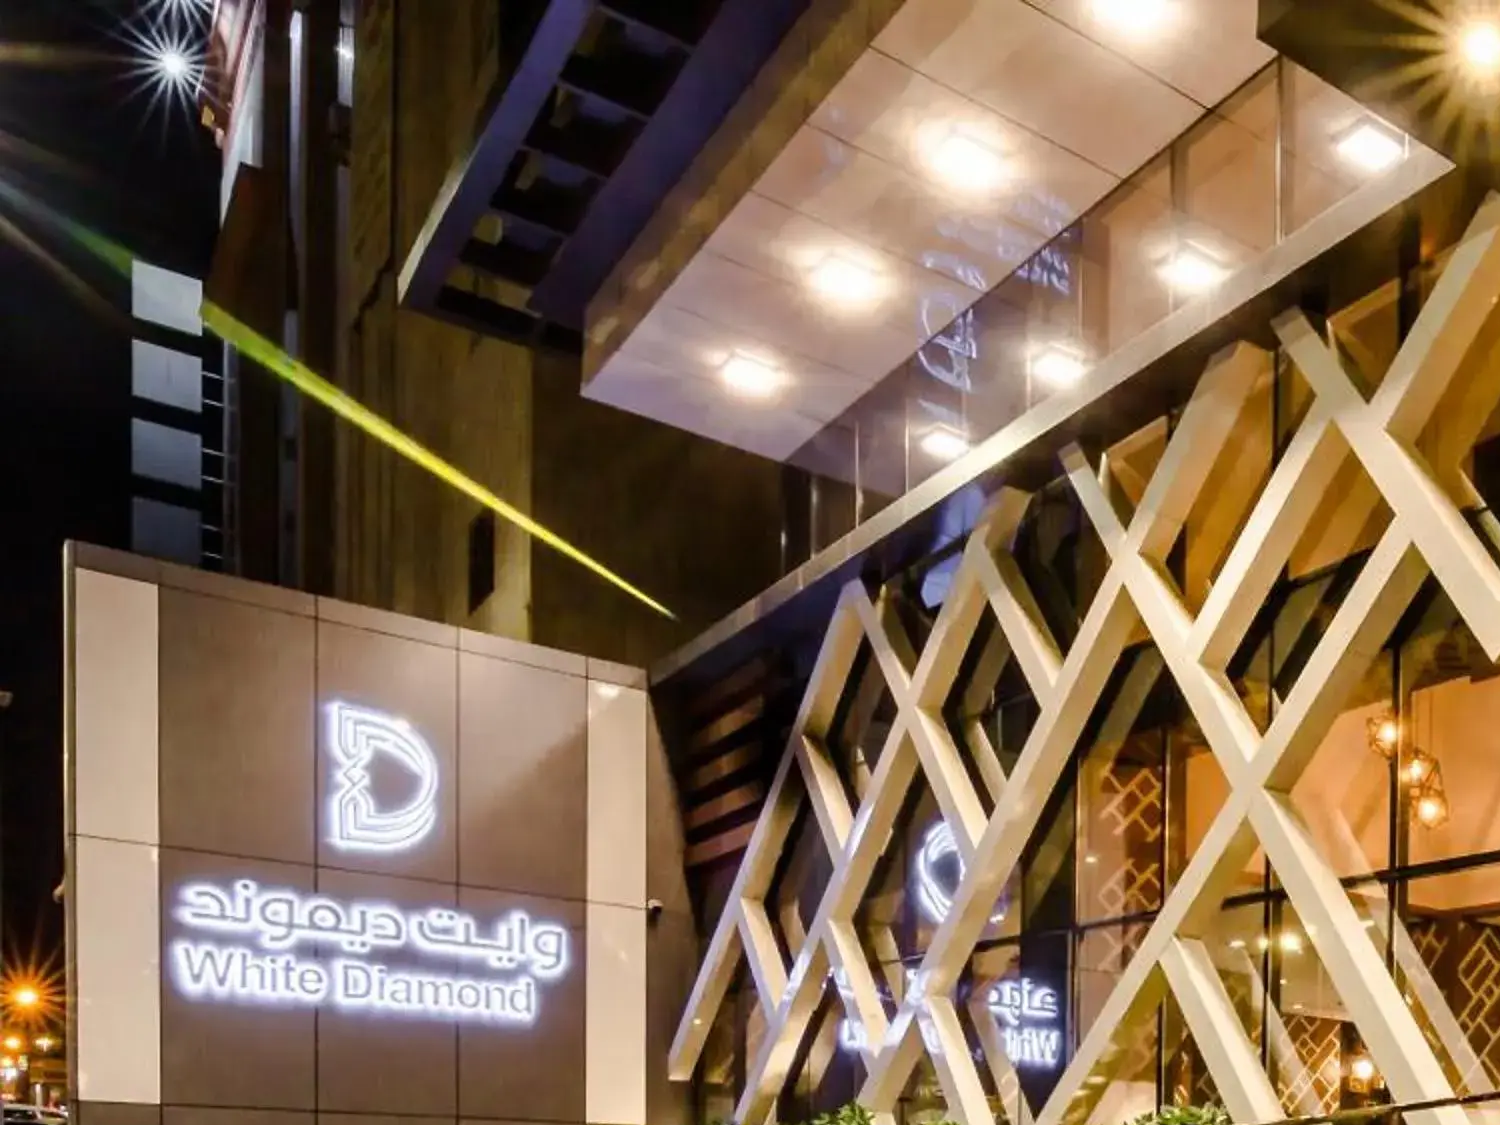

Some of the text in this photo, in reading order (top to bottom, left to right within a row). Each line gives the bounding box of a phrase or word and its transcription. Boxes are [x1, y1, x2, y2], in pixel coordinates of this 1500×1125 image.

[186, 880, 567, 971] وايت ديموند
[180, 944, 537, 1019] White Diamond
